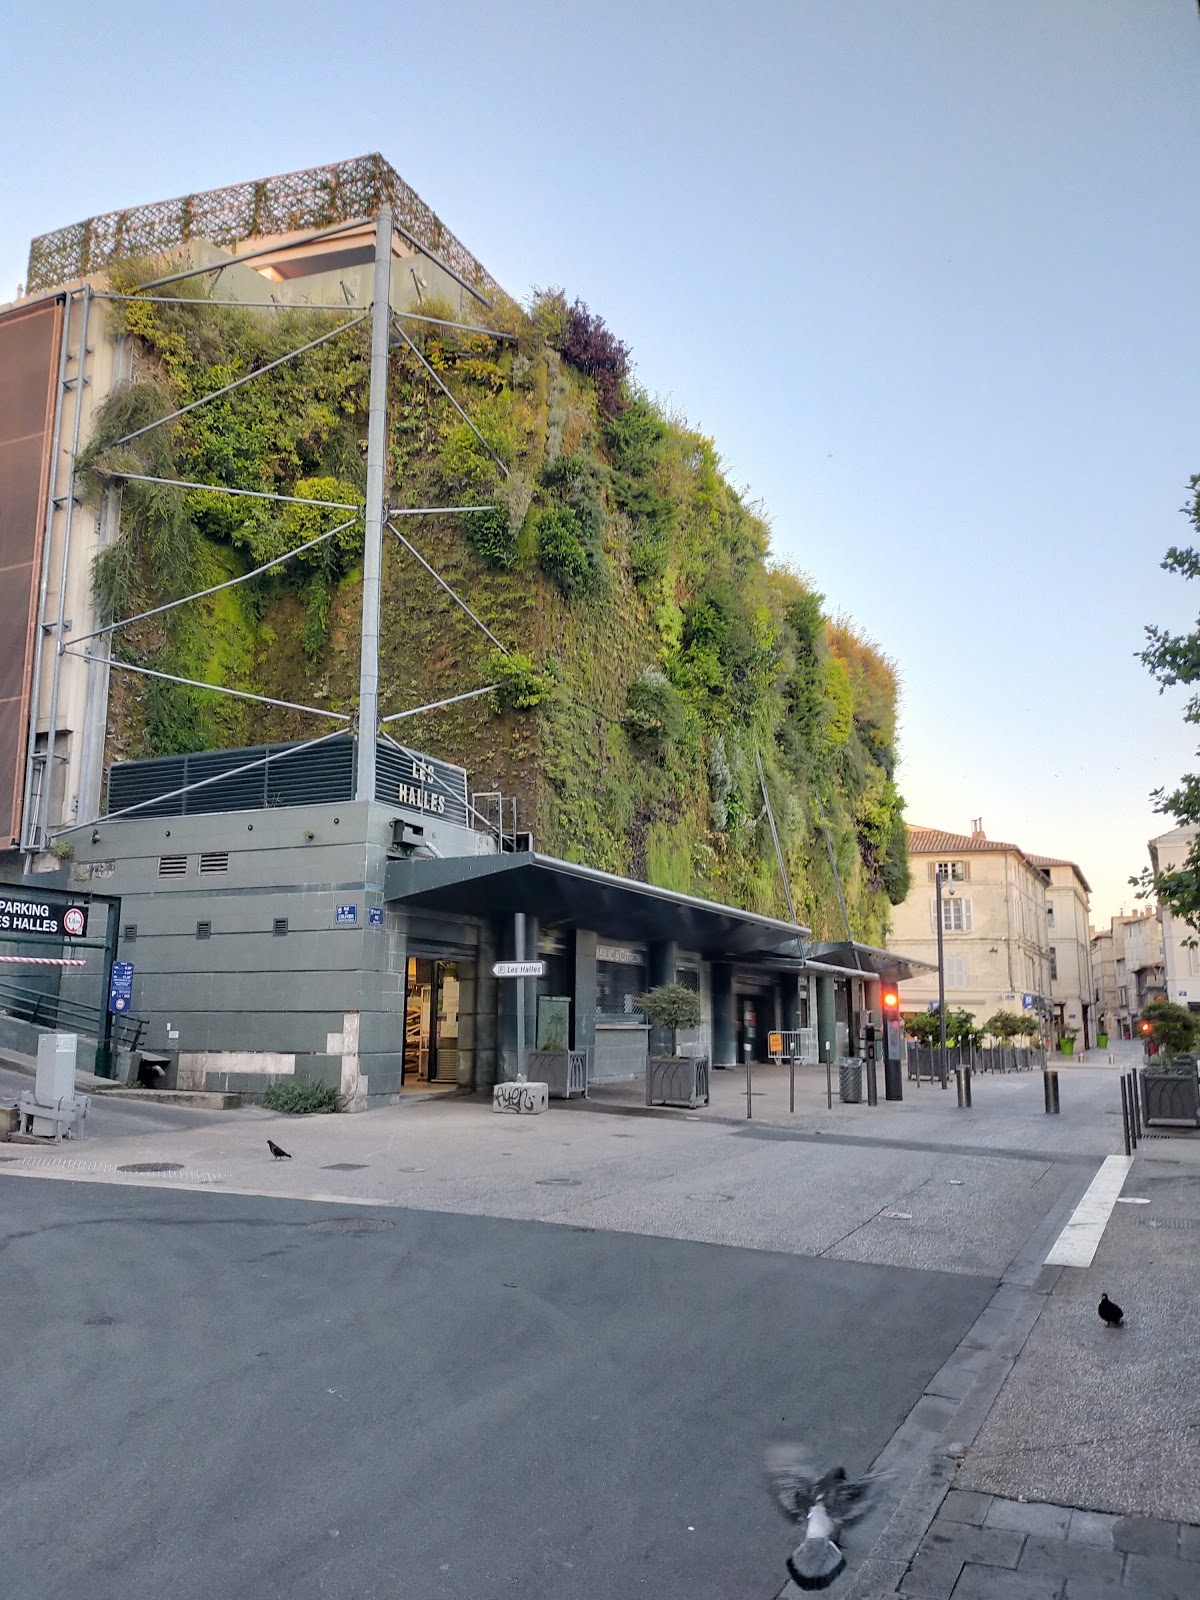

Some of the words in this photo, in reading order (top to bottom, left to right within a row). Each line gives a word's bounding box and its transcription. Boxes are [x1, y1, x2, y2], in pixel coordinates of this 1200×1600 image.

[412, 761, 434, 784] LES
[399, 783, 445, 814] HALLES
[0, 900, 49, 917] PARKING
[13, 917, 58, 932] HALLES
[520, 965, 541, 973] Halles
